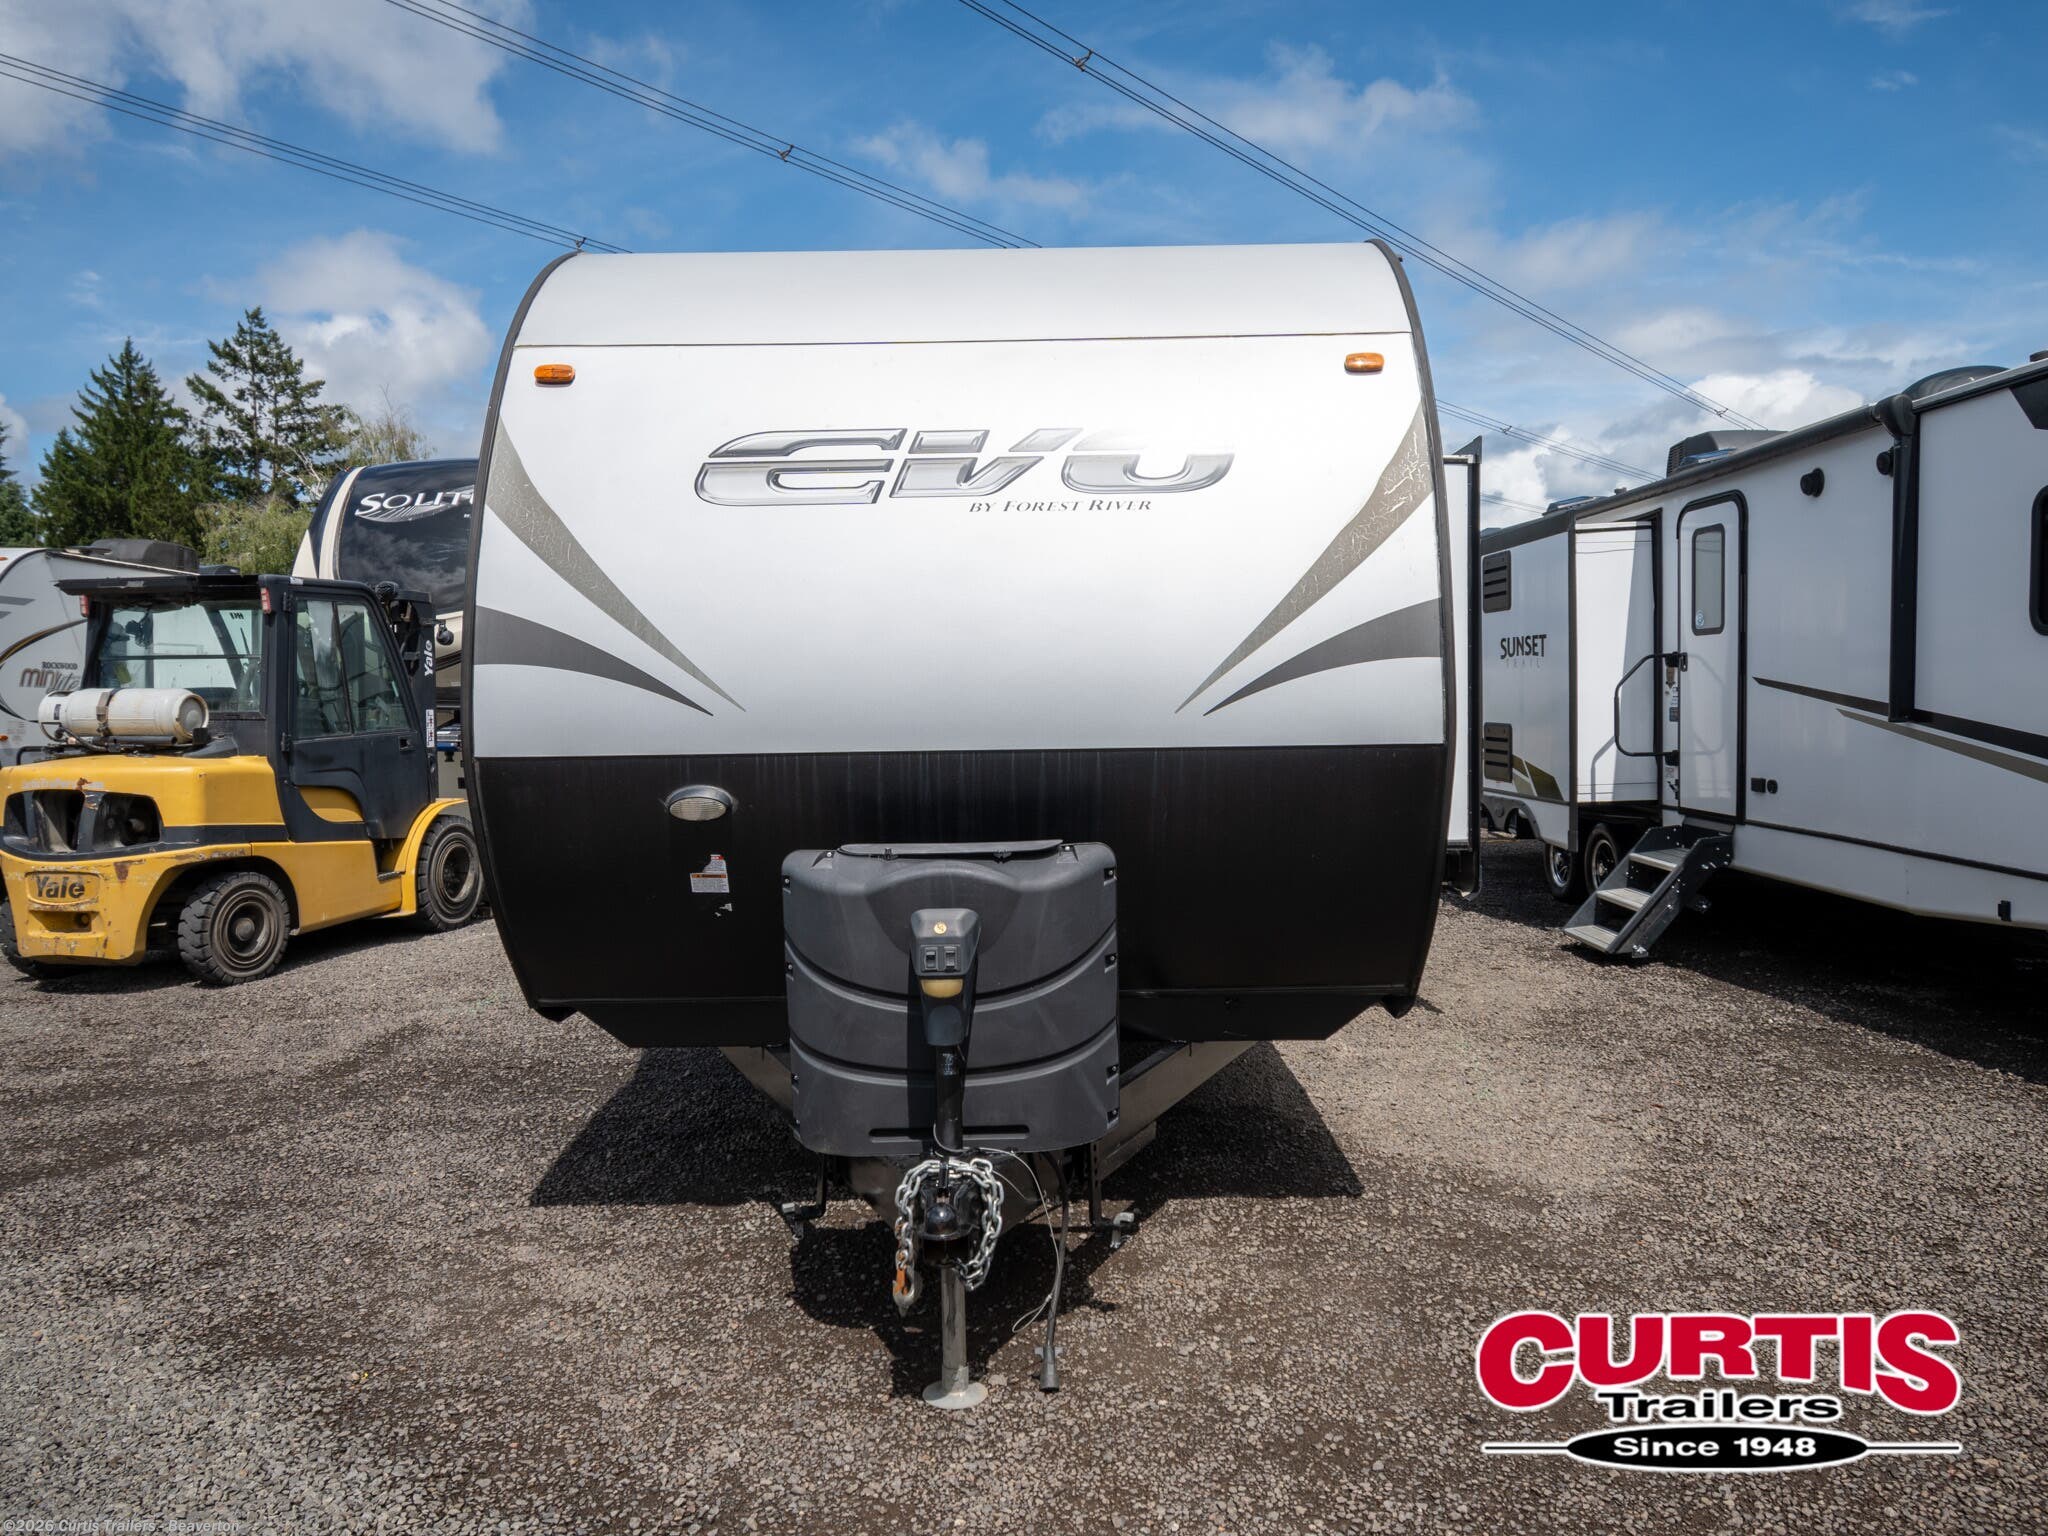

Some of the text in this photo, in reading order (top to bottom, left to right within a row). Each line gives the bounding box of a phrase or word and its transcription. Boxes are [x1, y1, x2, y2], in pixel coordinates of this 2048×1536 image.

[694, 428, 1235, 507] EVO
[354, 491, 475, 516] SOLIT
[1003, 501, 1081, 513] FOREST
[1088, 500, 1152, 511] RIVER
[424, 640, 434, 676] Yale
[1500, 634, 1547, 659] SUNSET
[36, 877, 85, 898] Yale
